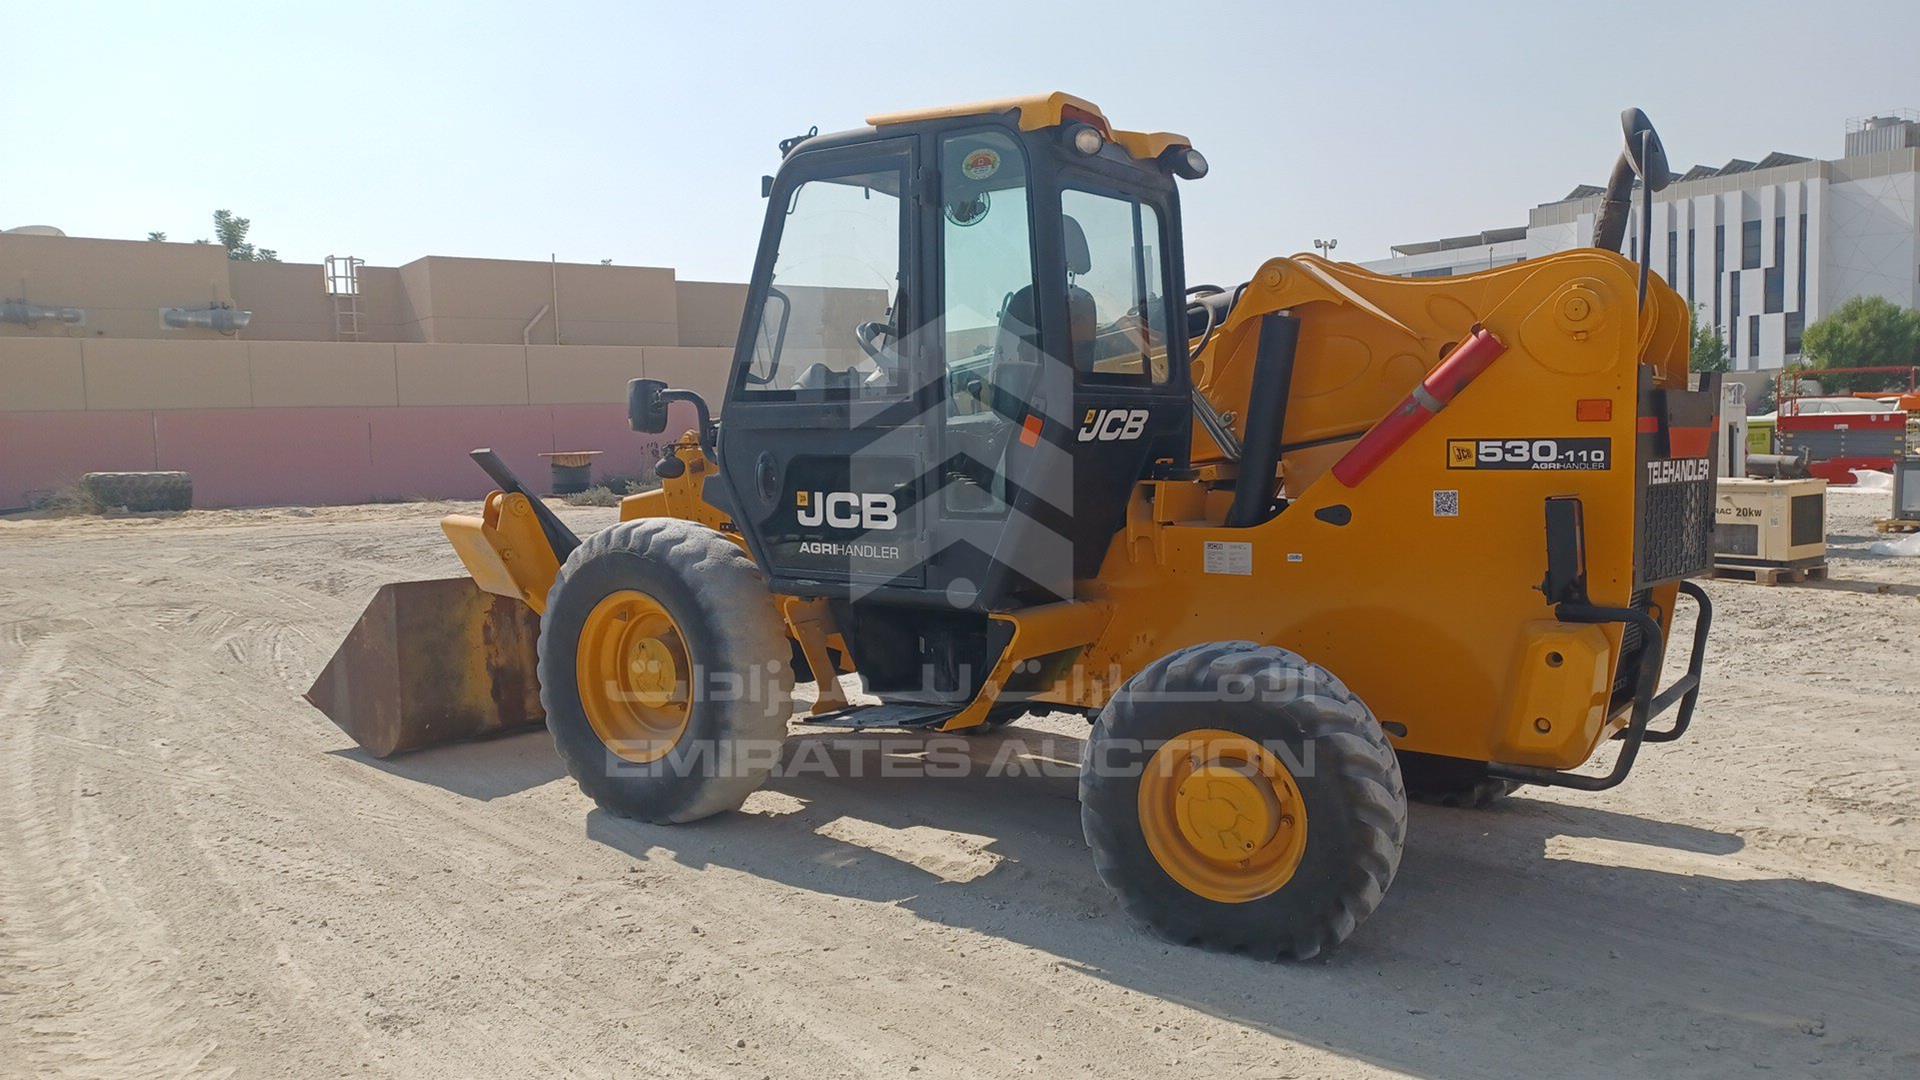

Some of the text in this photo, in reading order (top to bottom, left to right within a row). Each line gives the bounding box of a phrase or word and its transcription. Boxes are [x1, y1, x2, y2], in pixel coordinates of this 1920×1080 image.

[1078, 410, 1149, 441] JCB
[1478, 440, 1605, 463] 530-110
[1531, 462, 1605, 470] AGRIHANDLER
[1648, 459, 1709, 485] TELEHANDLER
[797, 491, 897, 530] JCB
[799, 542, 899, 559] AGRIHANDLER
